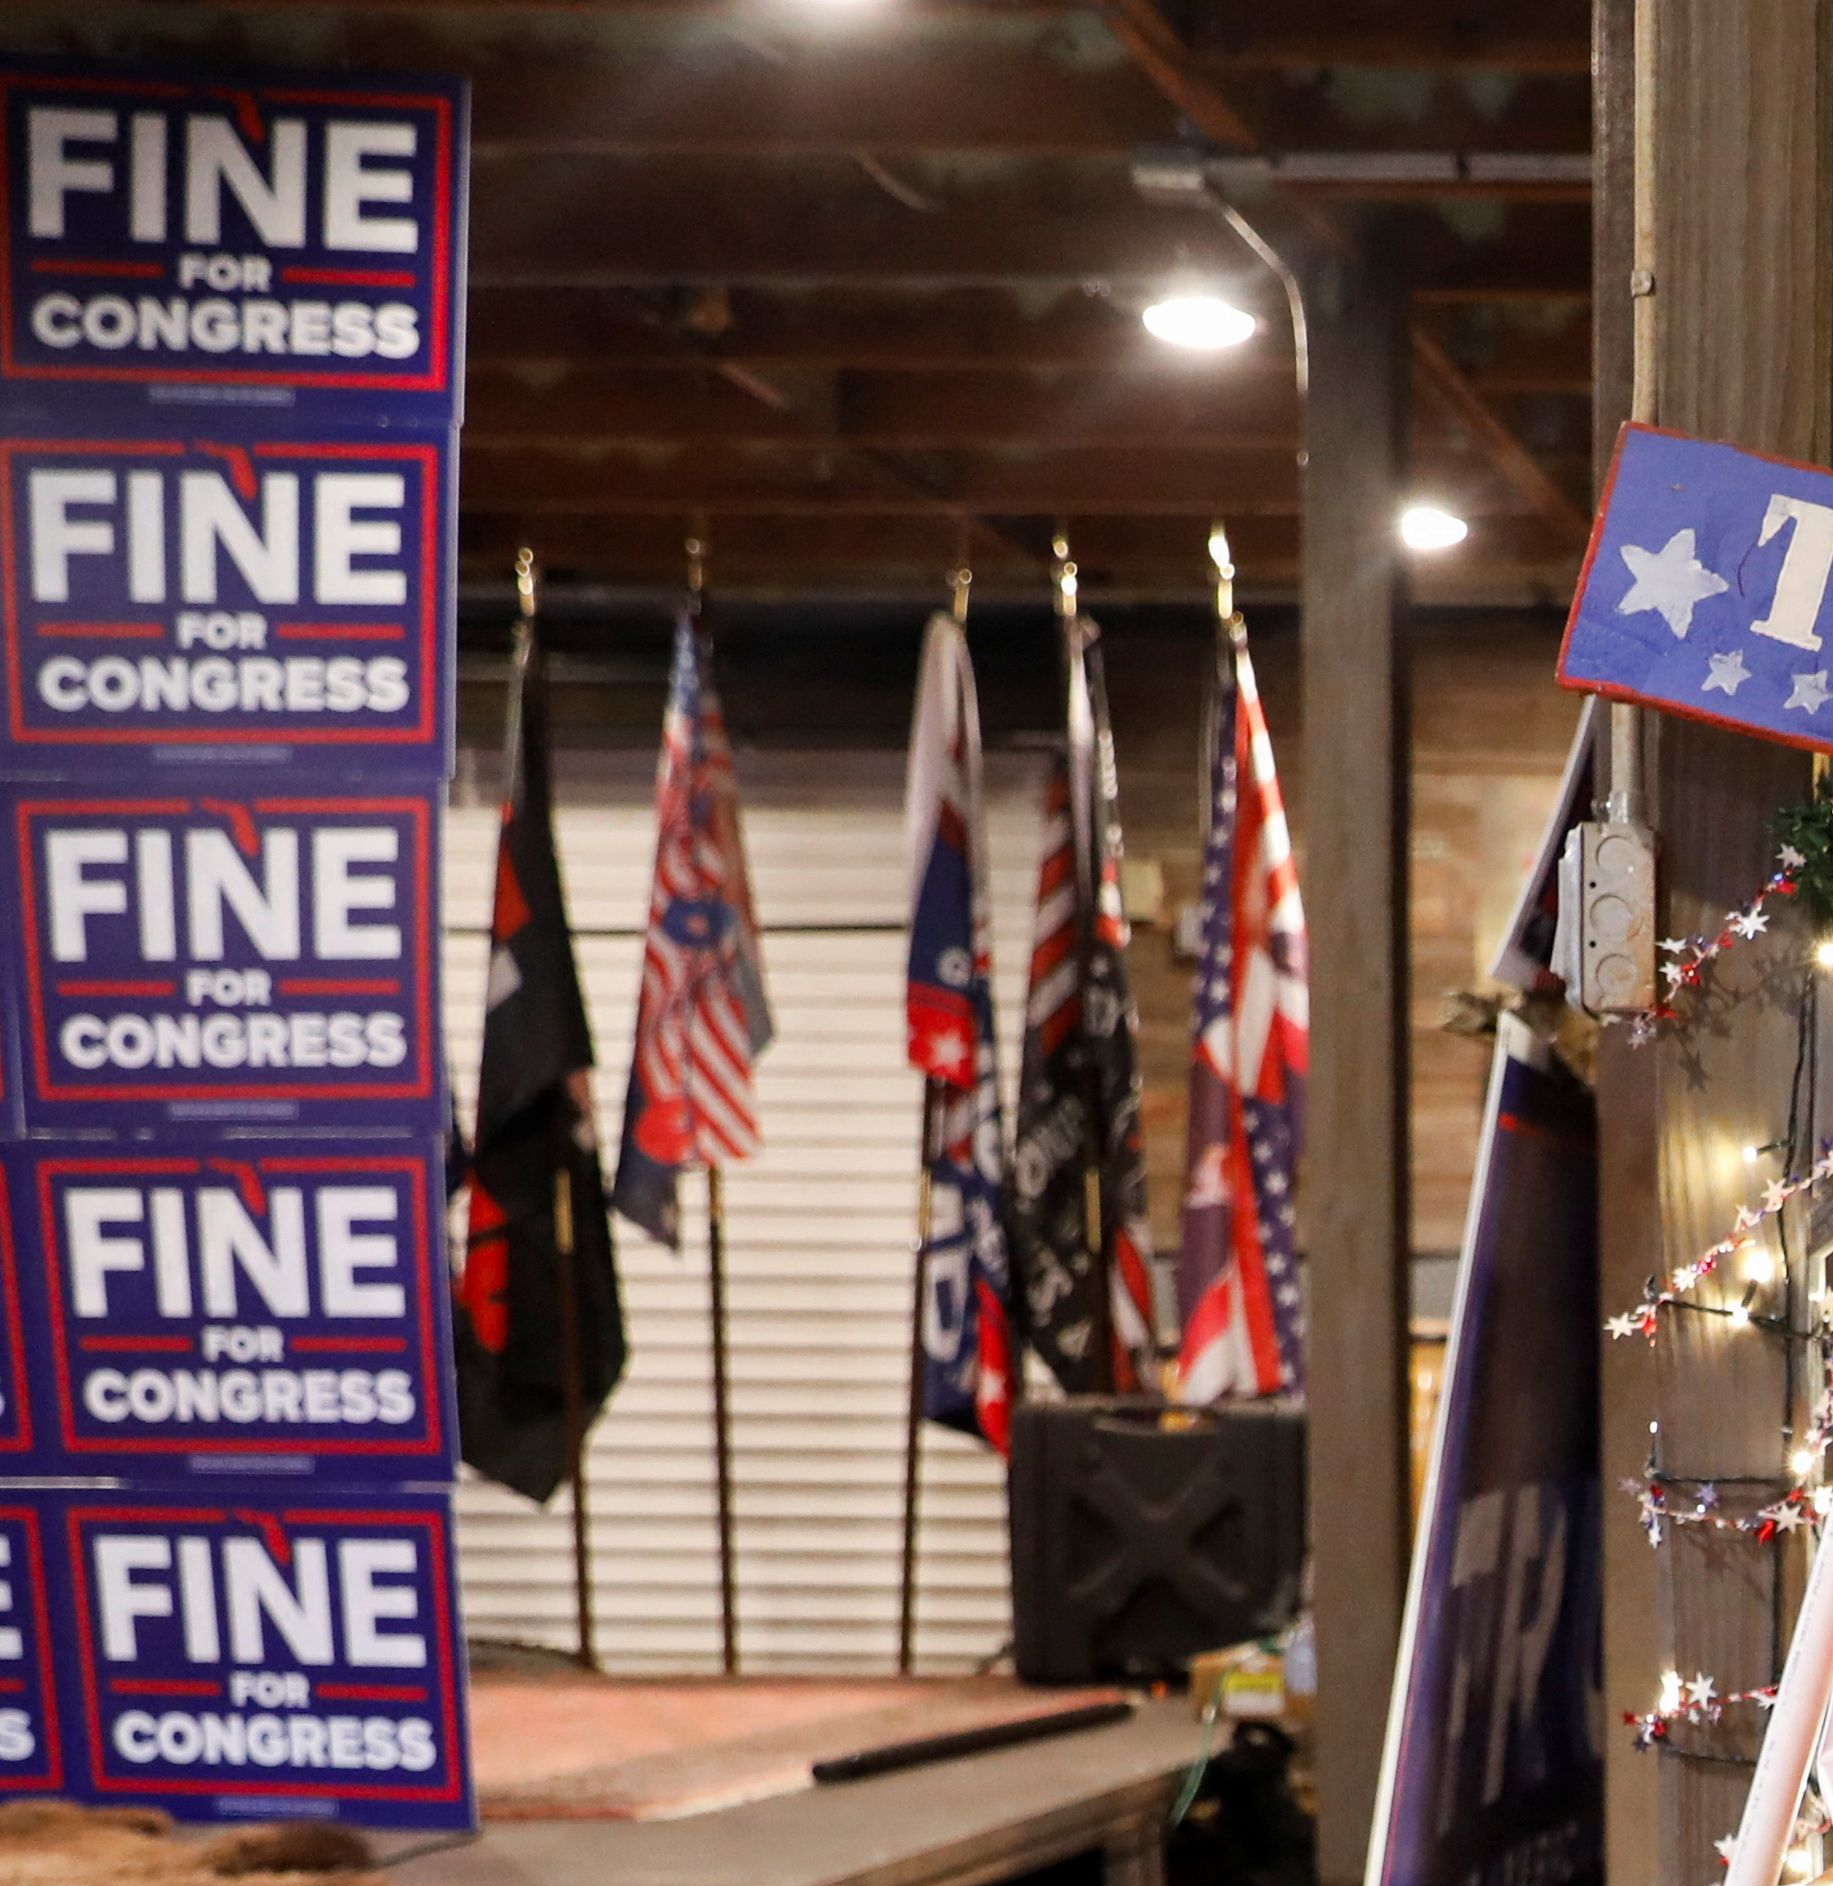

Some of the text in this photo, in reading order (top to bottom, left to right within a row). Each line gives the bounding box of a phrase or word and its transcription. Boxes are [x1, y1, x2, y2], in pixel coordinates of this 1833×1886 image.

[25, 106, 420, 254] FINE
[177, 255, 272, 293] FOR
[32, 293, 421, 360] CONGRESS
[28, 470, 408, 606] FINE
[176, 612, 268, 650] FOR
[38, 656, 411, 714] CONGRESS
[44, 827, 403, 963] FINE
[185, 968, 273, 1009] FOR
[59, 1011, 409, 1070] CONGRESS
[64, 1186, 408, 1320] FINE
[202, 1326, 285, 1364] FOR
[84, 1368, 416, 1426] CONGRESS
[93, 1535, 428, 1669] FINE
[230, 1672, 310, 1709] FOR
[113, 1710, 437, 1772] CONGRESS
